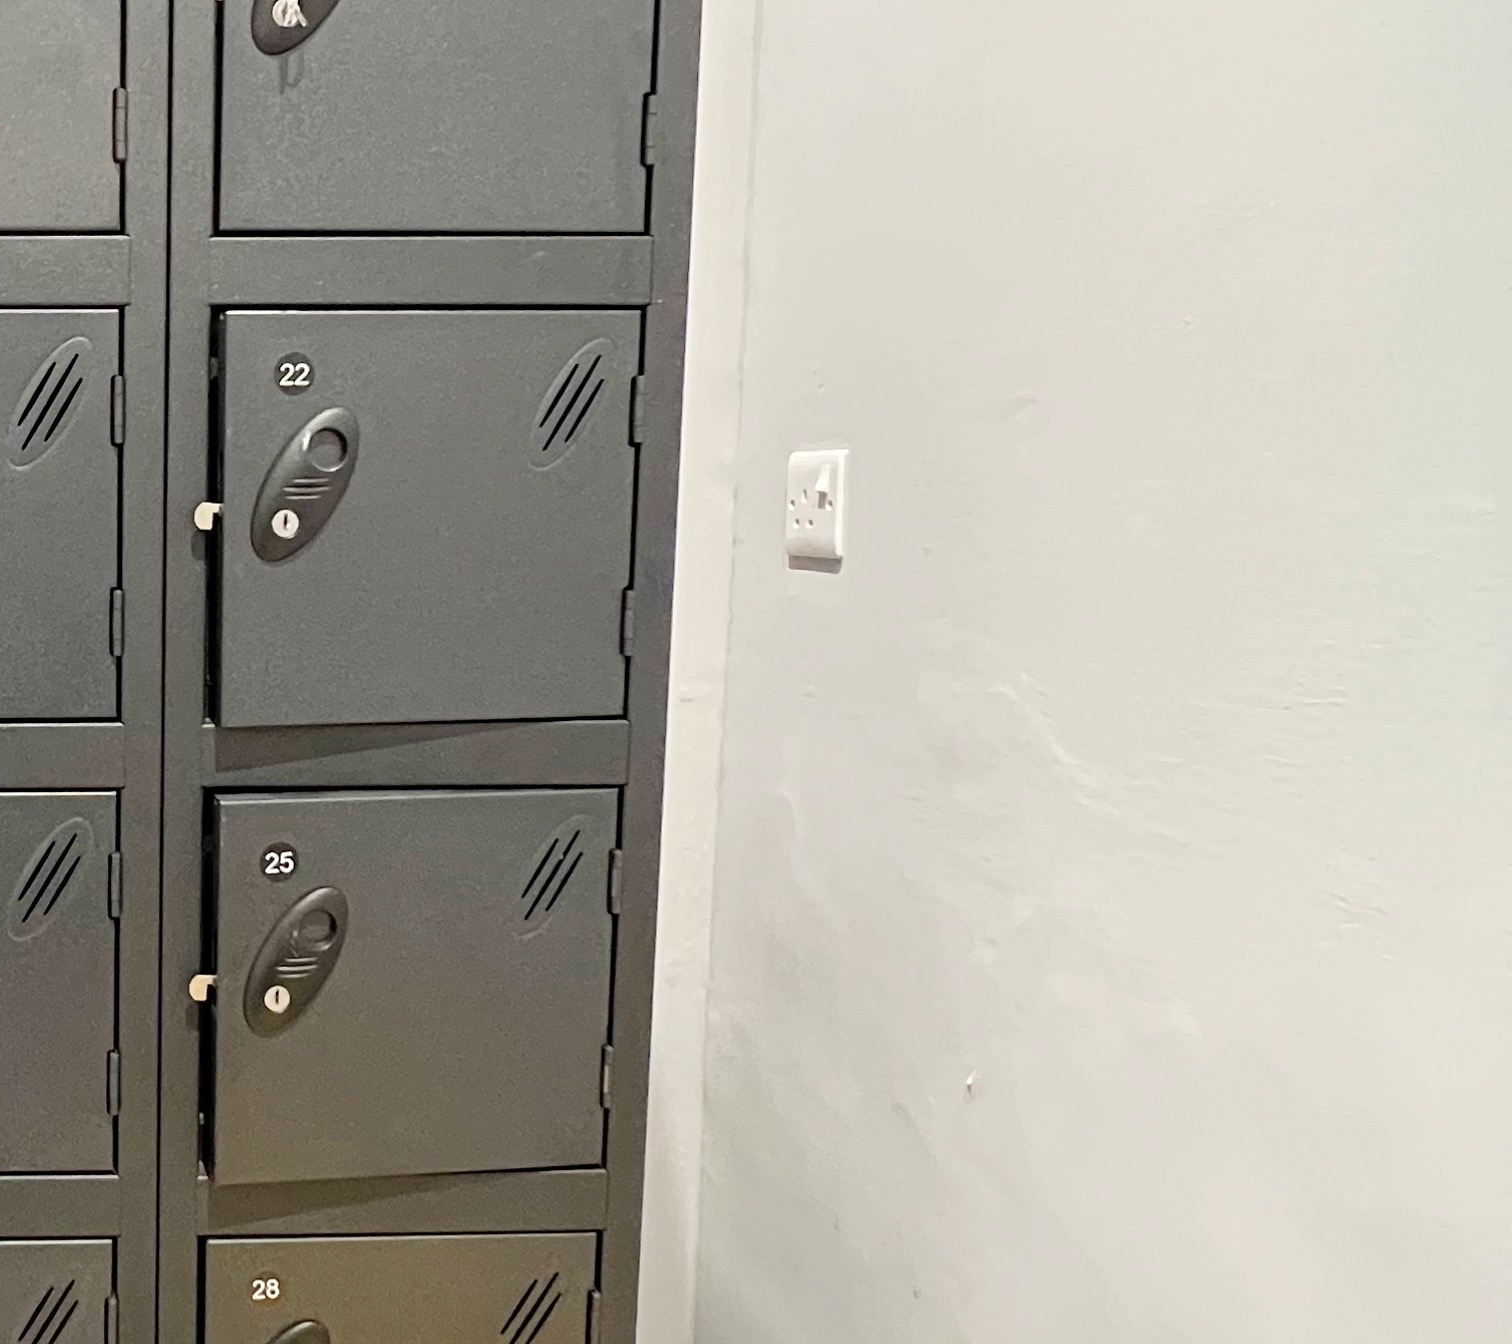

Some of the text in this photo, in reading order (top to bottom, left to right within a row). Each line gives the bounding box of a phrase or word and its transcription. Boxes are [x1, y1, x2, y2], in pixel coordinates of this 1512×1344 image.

[279, 362, 310, 386] 22
[264, 851, 294, 874] 25
[252, 1278, 280, 1301] 28
